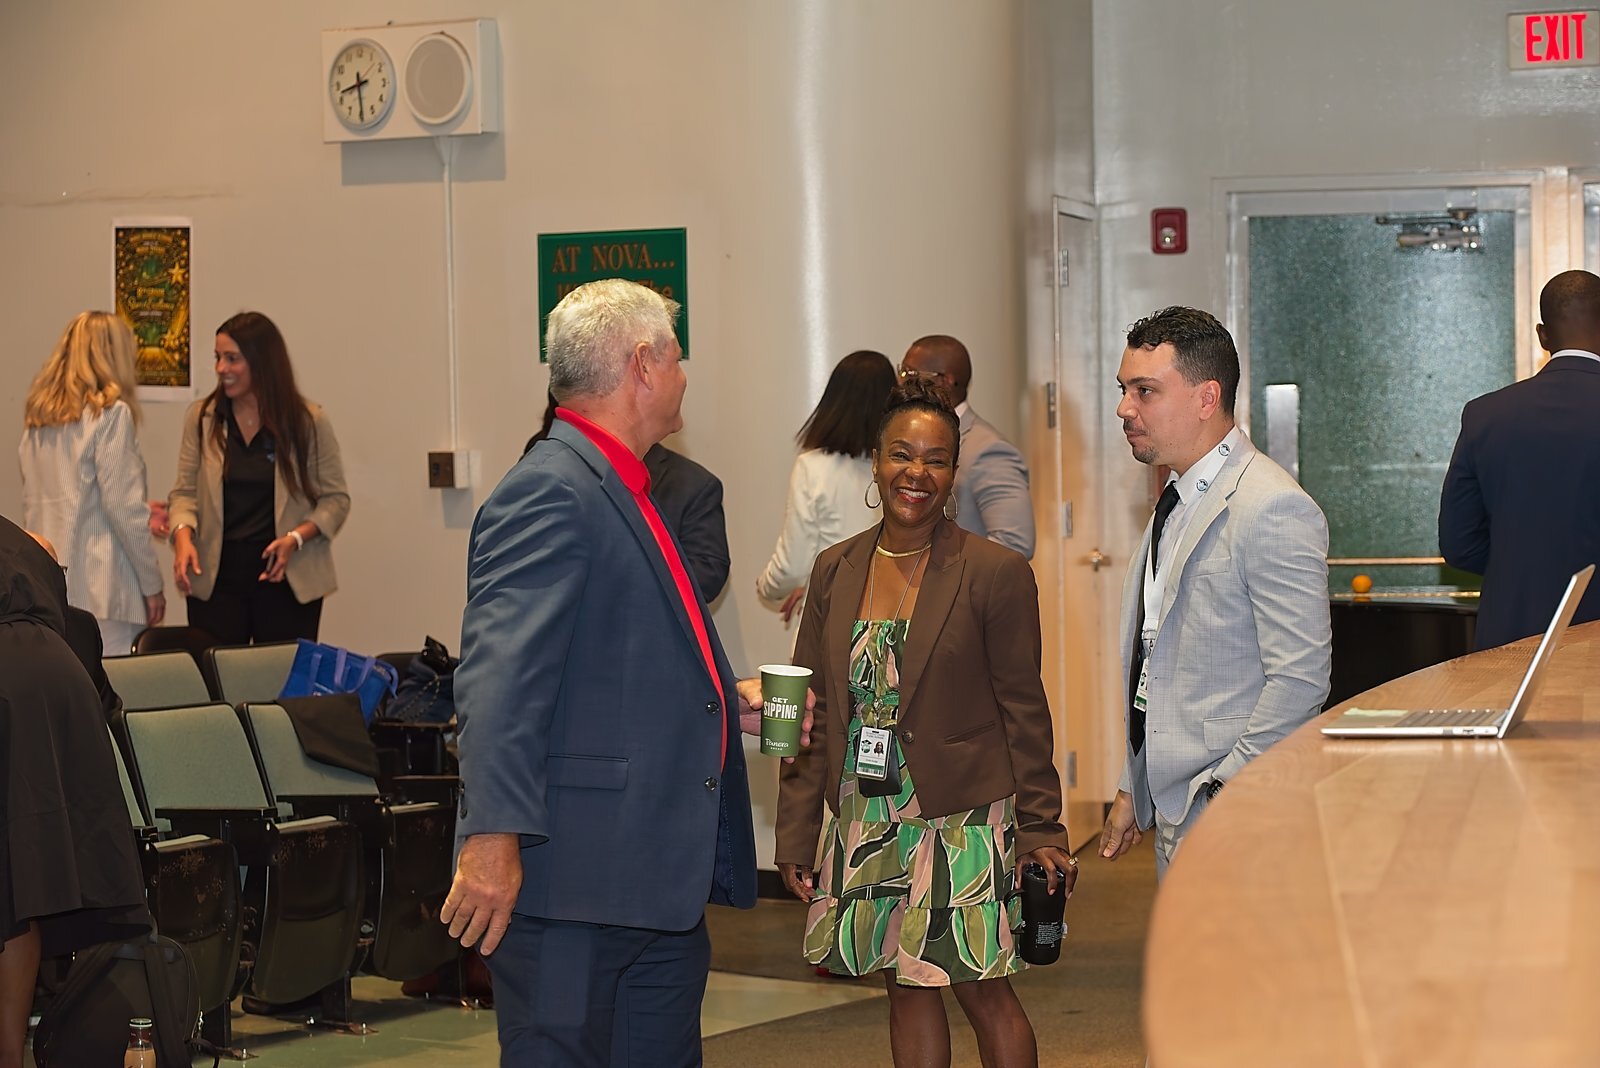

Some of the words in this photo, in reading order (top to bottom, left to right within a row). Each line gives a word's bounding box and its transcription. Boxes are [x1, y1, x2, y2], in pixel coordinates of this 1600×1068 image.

[1525, 13, 1587, 62] EXIT
[552, 246, 580, 273] AT
[592, 243, 675, 272] NOVA...
[763, 700, 798, 719] SIPPING
[772, 696, 789, 704] GET
[765, 738, 789, 748] Panera
